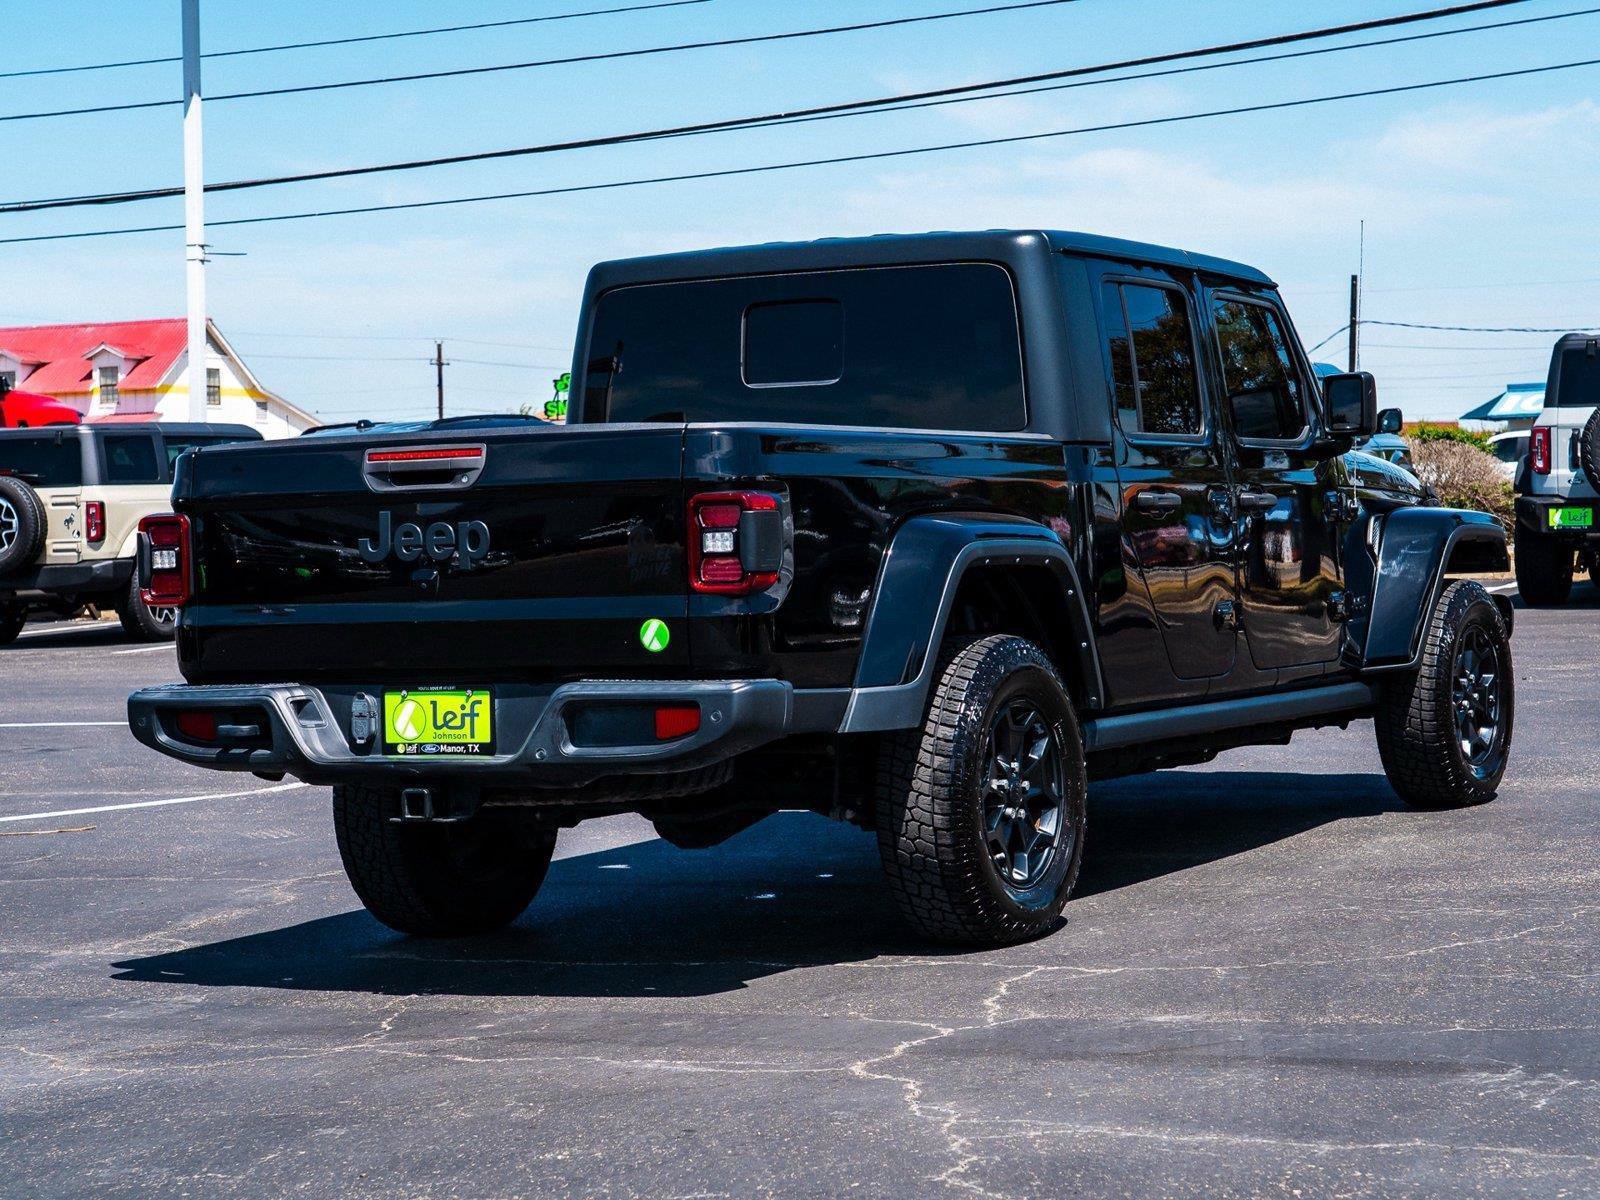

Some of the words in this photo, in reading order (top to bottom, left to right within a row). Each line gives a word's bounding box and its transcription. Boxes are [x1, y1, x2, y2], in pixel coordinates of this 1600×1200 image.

[357, 510, 490, 570] Jeep
[430, 699, 482, 739] leif
[432, 731, 467, 740] Johnson
[440, 744, 466, 754] Manor,
[468, 744, 480, 753] TX
